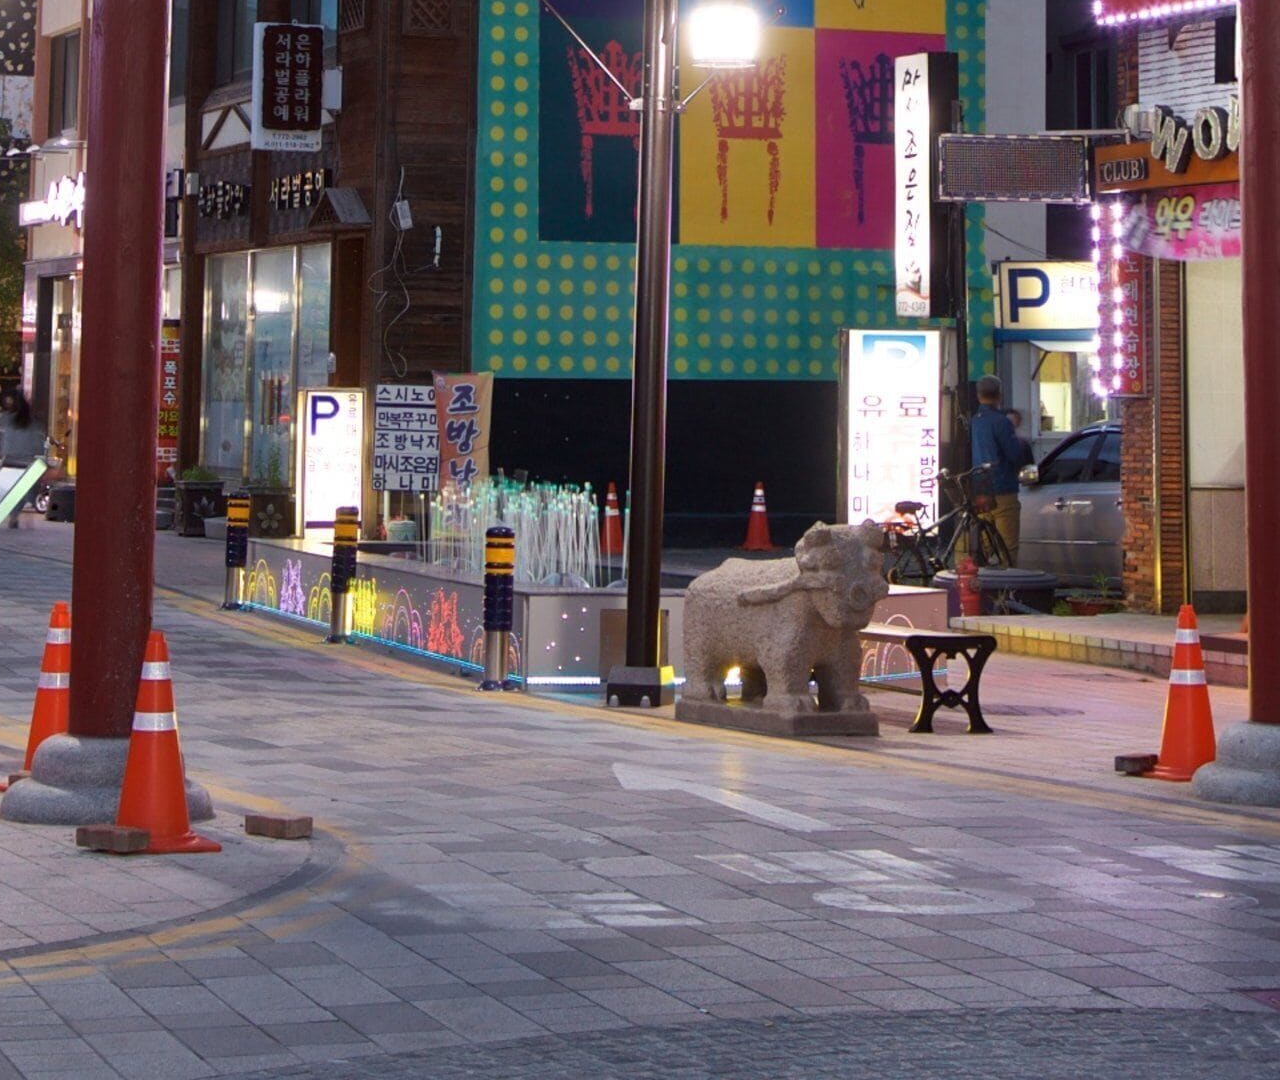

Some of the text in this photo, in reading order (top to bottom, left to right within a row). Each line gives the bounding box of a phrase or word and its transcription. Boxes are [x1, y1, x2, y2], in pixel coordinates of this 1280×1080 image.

[1008, 268, 1051, 323] P
[310, 395, 341, 436] P
[857, 395, 929, 419] 유료
